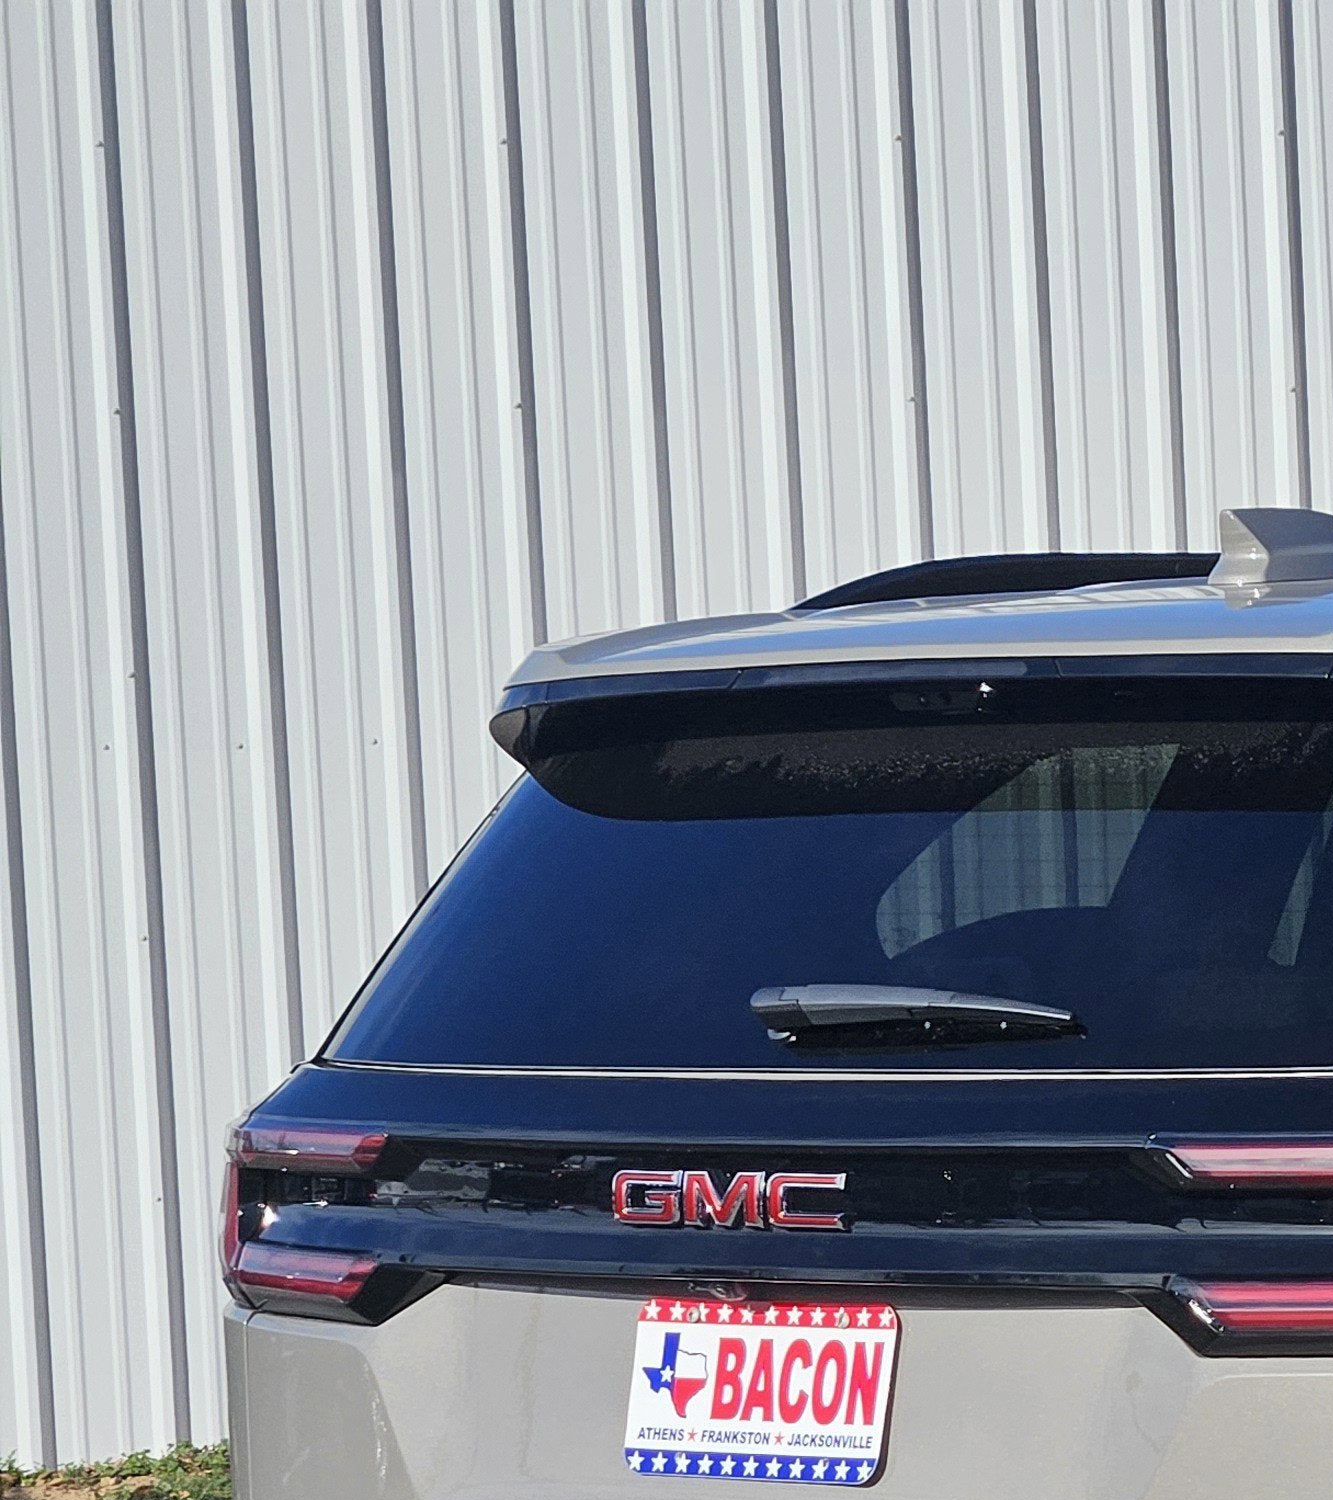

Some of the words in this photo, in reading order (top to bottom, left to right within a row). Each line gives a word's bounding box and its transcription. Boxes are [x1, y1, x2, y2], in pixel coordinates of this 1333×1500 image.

[612, 1170, 848, 1230] GMC
[709, 1336, 885, 1426] BACON
[637, 1426, 685, 1442] ATHENS
[700, 1430, 771, 1446] FRANKSTON
[787, 1433, 874, 1450] JACKSONVILLE
